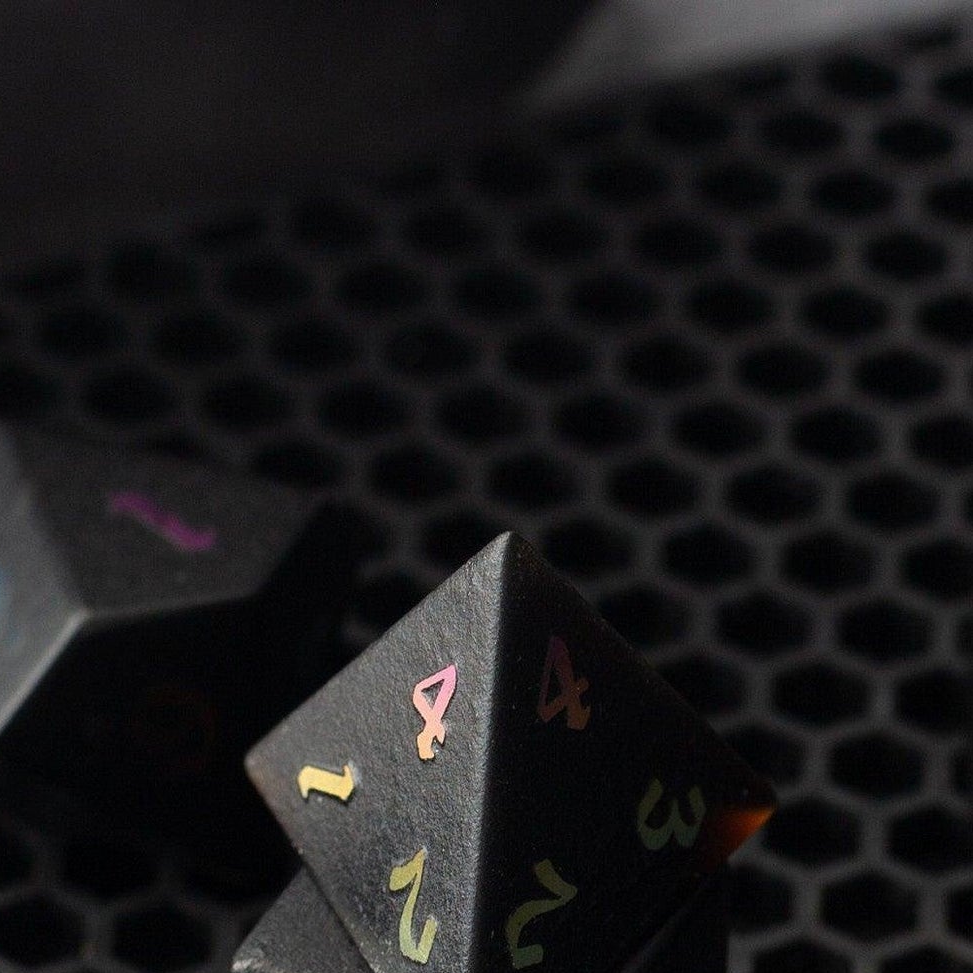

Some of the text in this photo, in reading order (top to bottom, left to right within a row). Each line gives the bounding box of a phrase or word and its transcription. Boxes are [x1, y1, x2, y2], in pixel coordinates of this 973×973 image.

[538, 635, 593, 732] 4
[635, 777, 707, 851] 3
[503, 858, 578, 970] 2
